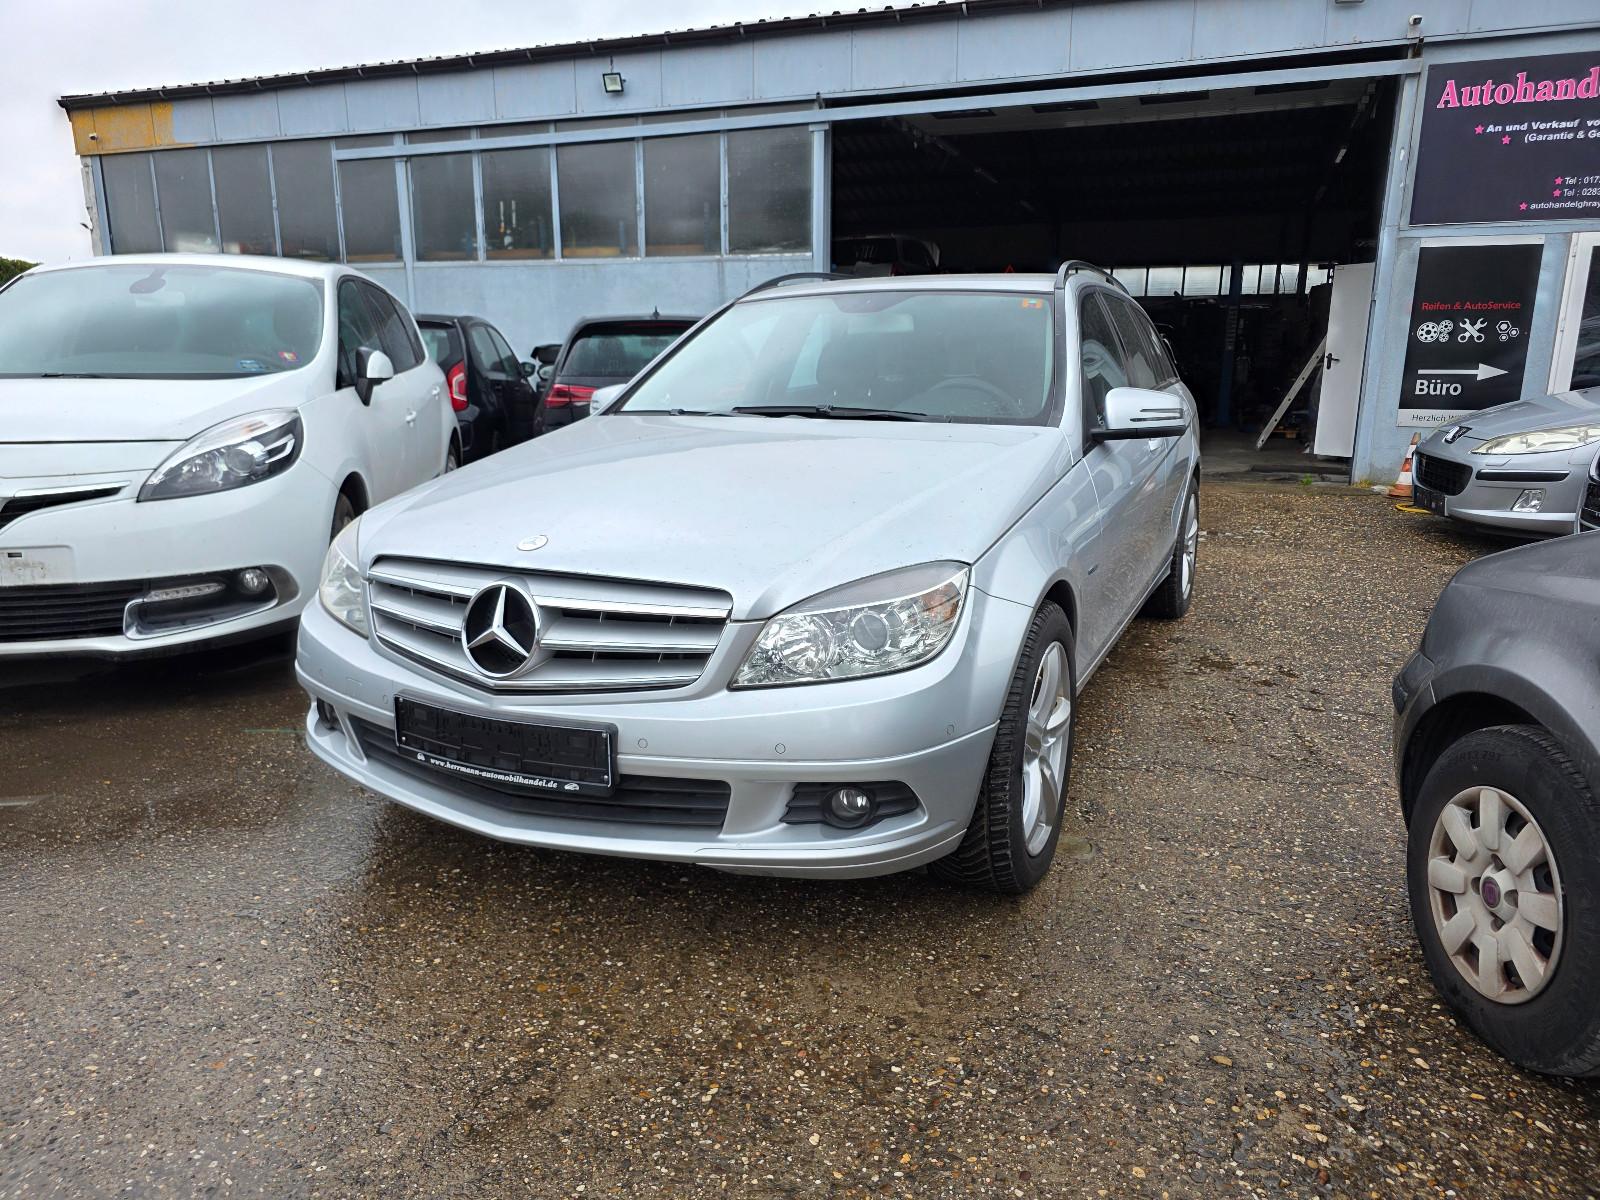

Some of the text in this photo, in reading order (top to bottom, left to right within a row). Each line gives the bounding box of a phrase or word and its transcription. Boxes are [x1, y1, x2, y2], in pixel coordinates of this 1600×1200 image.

[1437, 66, 1600, 108] Autohand
[1486, 124, 1502, 133] An
[1505, 122, 1528, 132] und
[1531, 119, 1581, 130] Verkauf
[1524, 131, 1574, 143] (Garantie
[1576, 130, 1585, 139] &
[1564, 177, 1577, 185] Tel
[1583, 176, 1600, 184] 017
[1563, 188, 1575, 197] Tel
[1422, 301, 1521, 311] Reifen & AutoService
[1414, 379, 1462, 396] Büro
[1411, 414, 1446, 422] Herzlich
[430, 757, 558, 789] www.herrmann-automobilhandel.de
